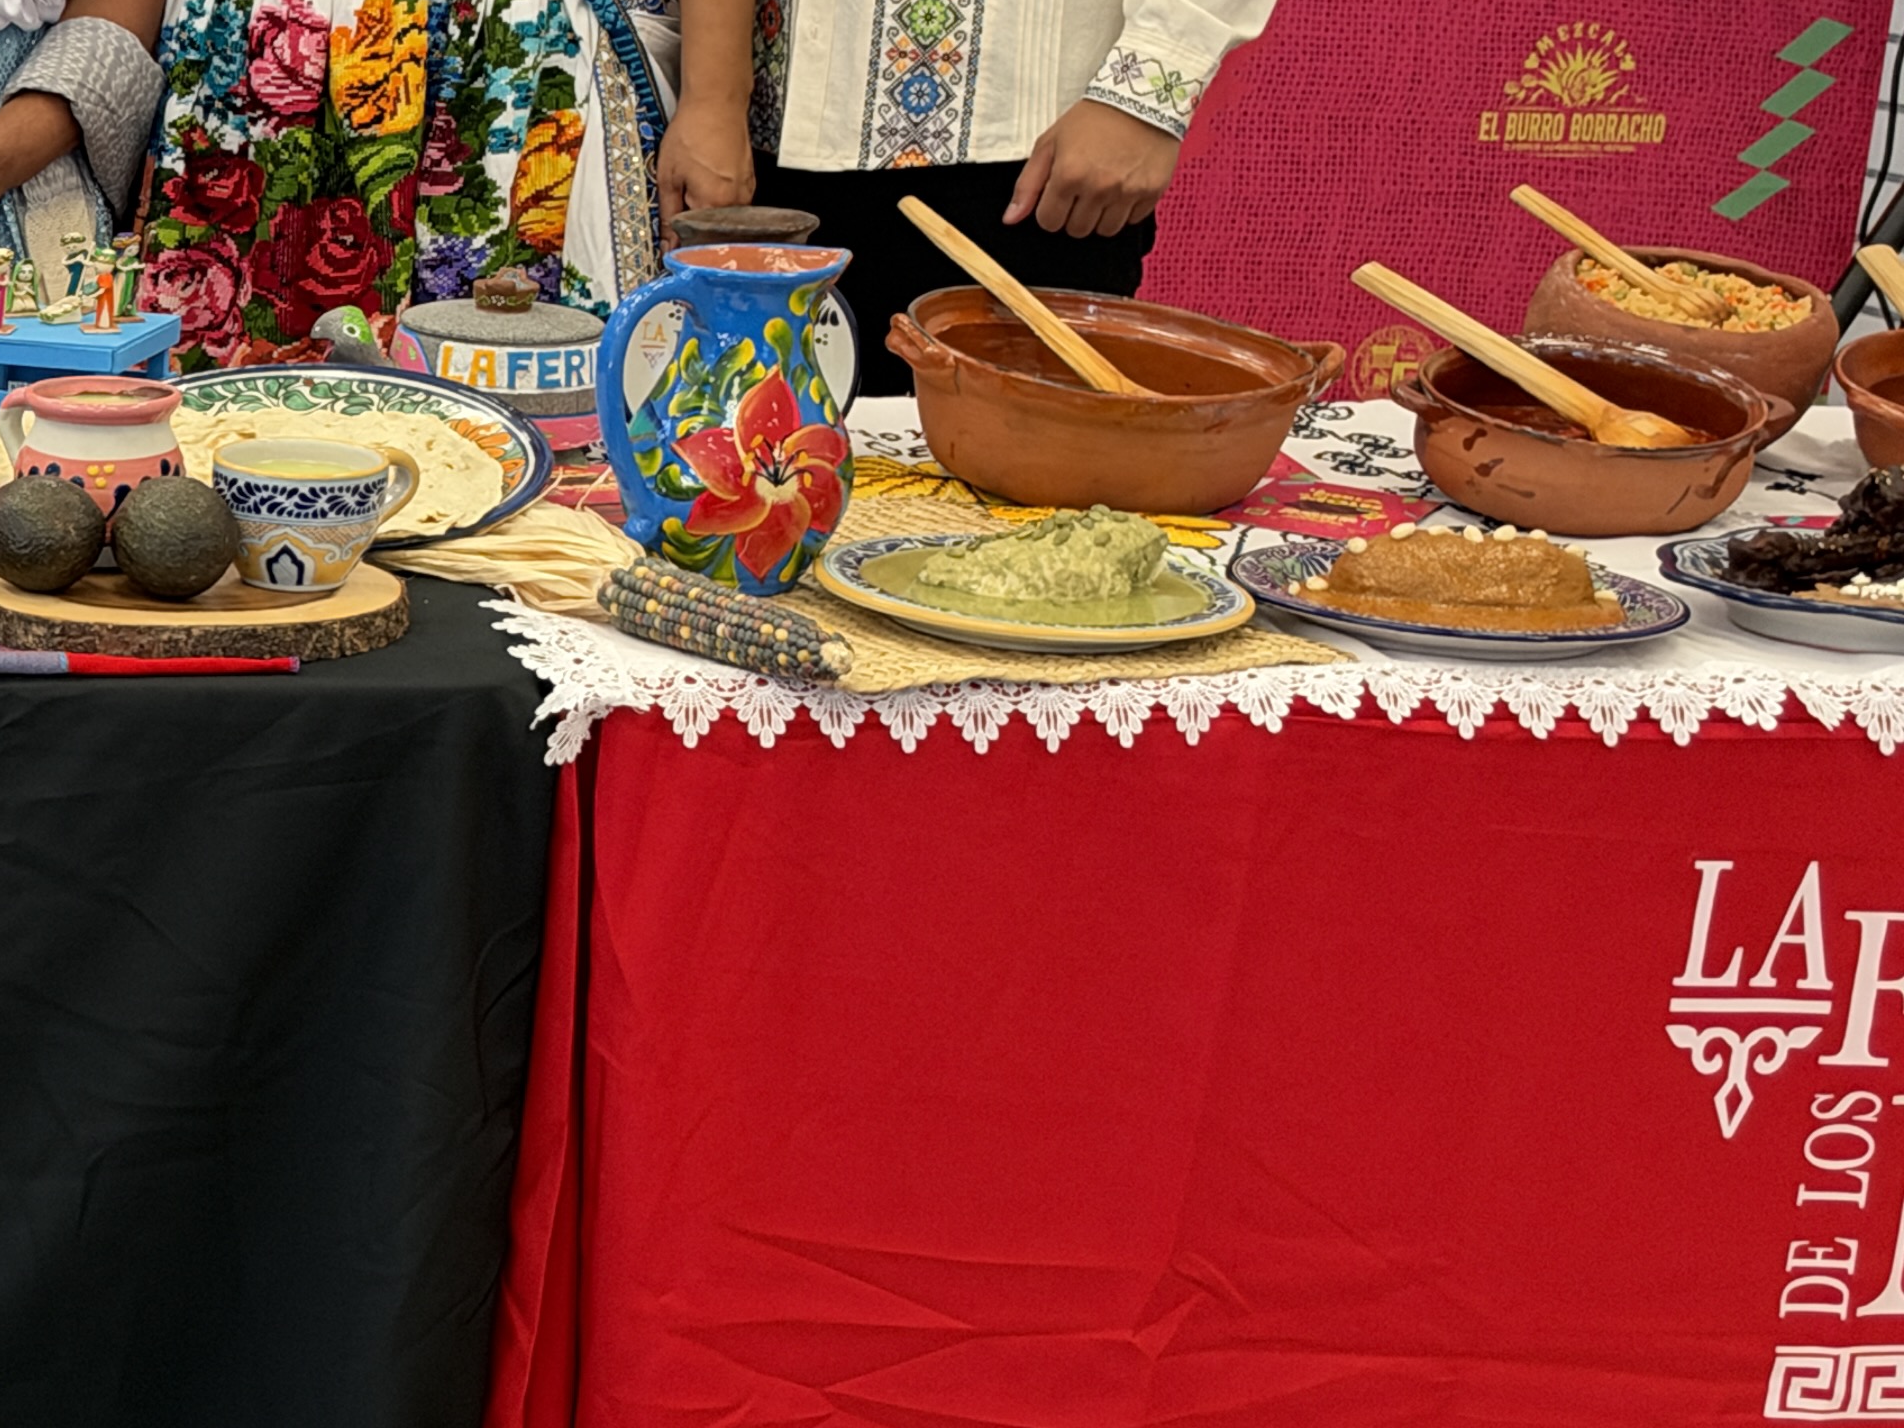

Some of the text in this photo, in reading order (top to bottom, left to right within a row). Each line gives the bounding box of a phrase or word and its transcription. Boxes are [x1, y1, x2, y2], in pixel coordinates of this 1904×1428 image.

[1536, 23, 1627, 57] MEZCAL
[1478, 111, 1666, 143] EL BURRO BORRACHO
[642, 321, 668, 342] LA
[440, 345, 594, 390] LA FER
[1671, 861, 1834, 991] LA
[1796, 1089, 1883, 1210] LOS
[1778, 1237, 1859, 1322] DE
